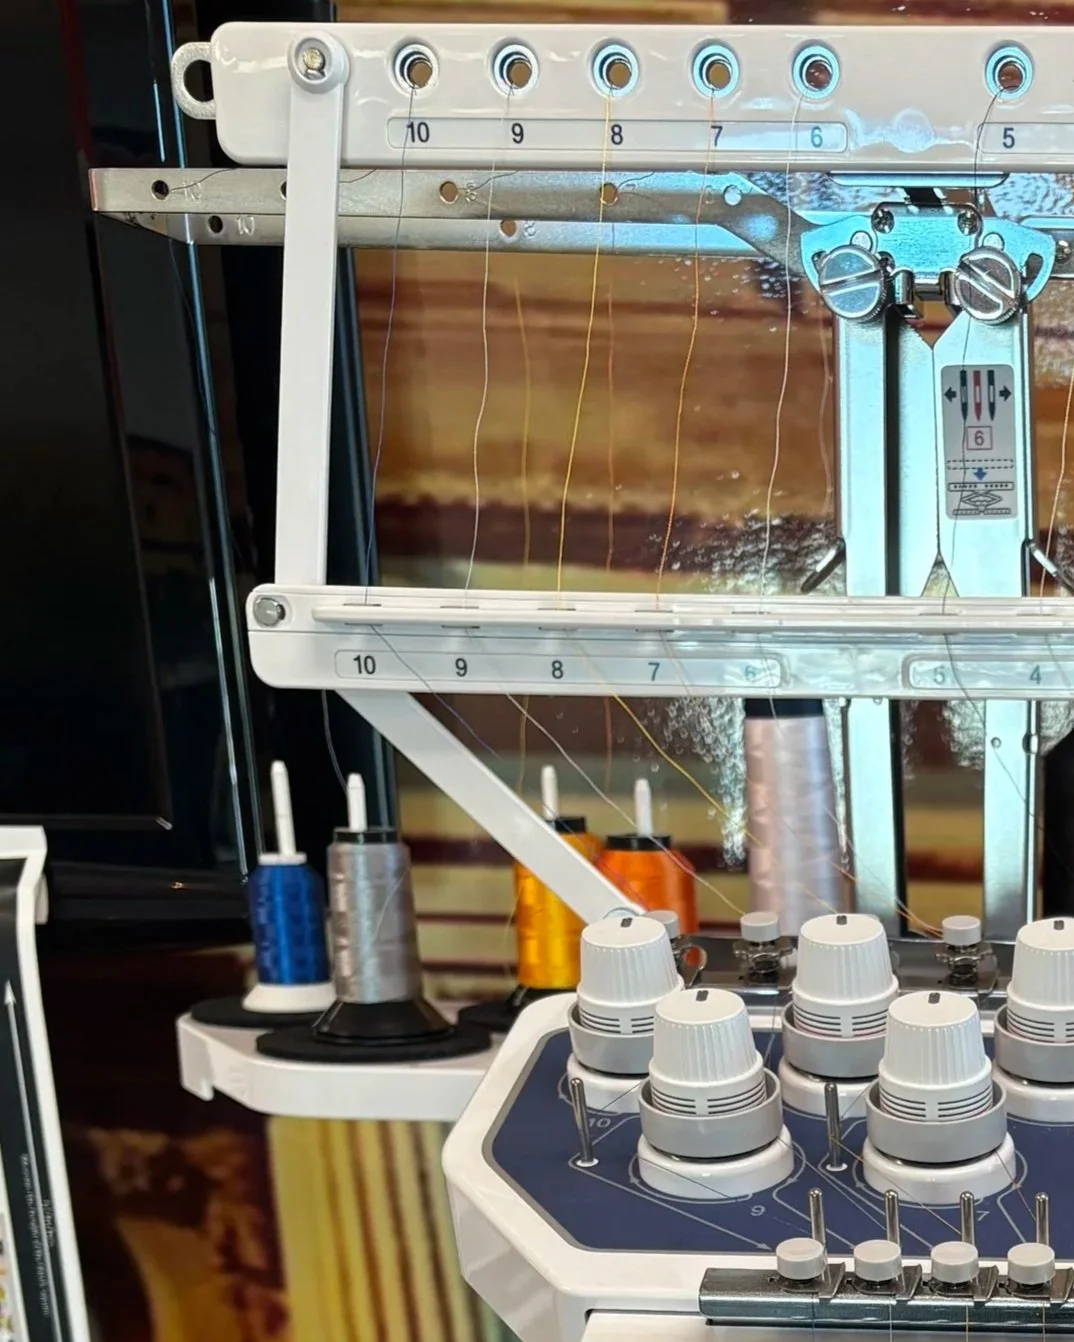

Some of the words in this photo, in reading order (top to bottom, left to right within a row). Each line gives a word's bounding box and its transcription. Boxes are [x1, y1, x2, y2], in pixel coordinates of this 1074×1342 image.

[406, 122, 430, 143] 10
[511, 124, 525, 144] 9
[610, 124, 624, 145] 8
[711, 126, 723, 147] 7
[810, 127, 823, 148] 6
[1002, 128, 1015, 149] 5
[238, 216, 254, 234] 10
[975, 431, 984, 446] 6
[353, 655, 376, 675] 10
[455, 658, 467, 677] 9
[552, 661, 564, 679] 8
[648, 663, 660, 681] 7
[745, 666, 756, 682] 6
[933, 666, 945, 685] 5
[1029, 666, 1041, 685] 4
[588, 1116, 612, 1128] 10
[750, 1205, 765, 1216] 9
[976, 1211, 990, 1221] 7
